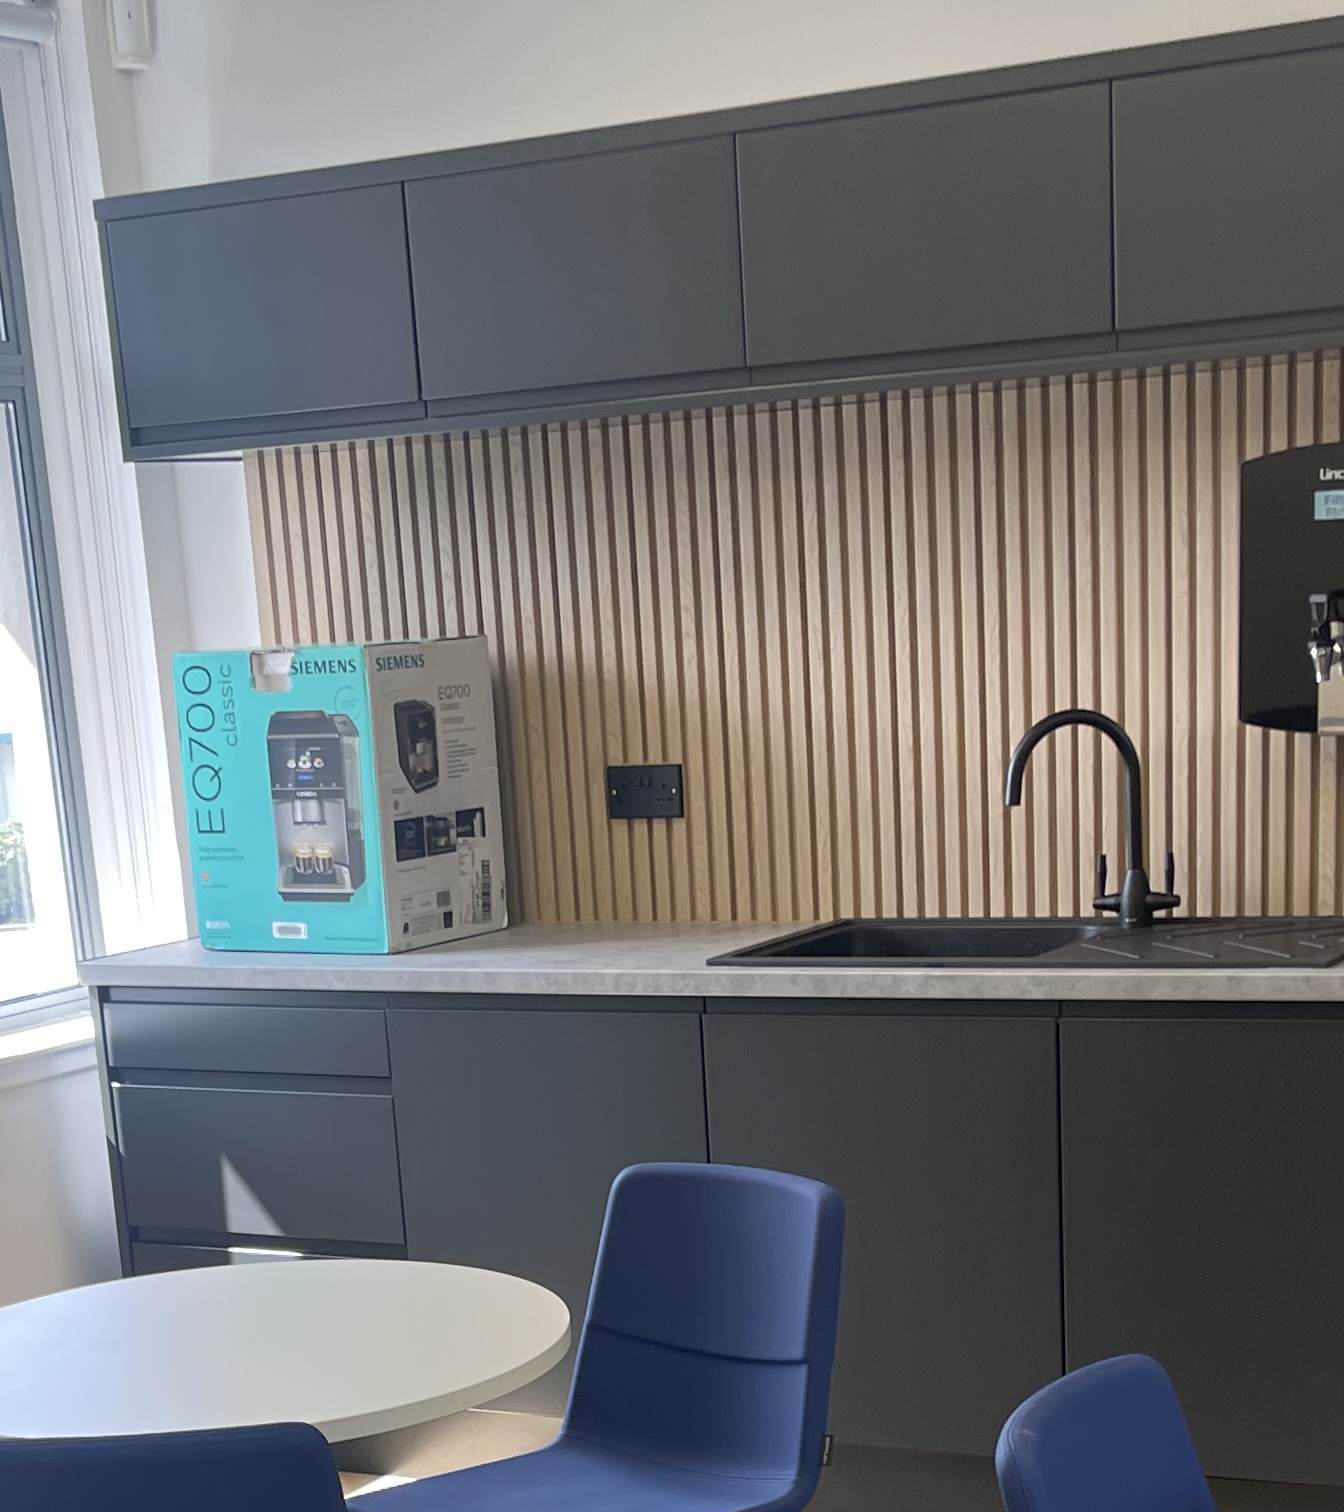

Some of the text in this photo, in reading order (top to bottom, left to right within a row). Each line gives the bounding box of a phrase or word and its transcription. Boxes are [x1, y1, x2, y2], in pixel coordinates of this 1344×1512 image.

[291, 659, 357, 676] SIEMENS
[375, 653, 425, 672] SIEMENS
[437, 683, 471, 700] EQ700
[217, 664, 238, 747] classic
[182, 665, 226, 834] EQ700
